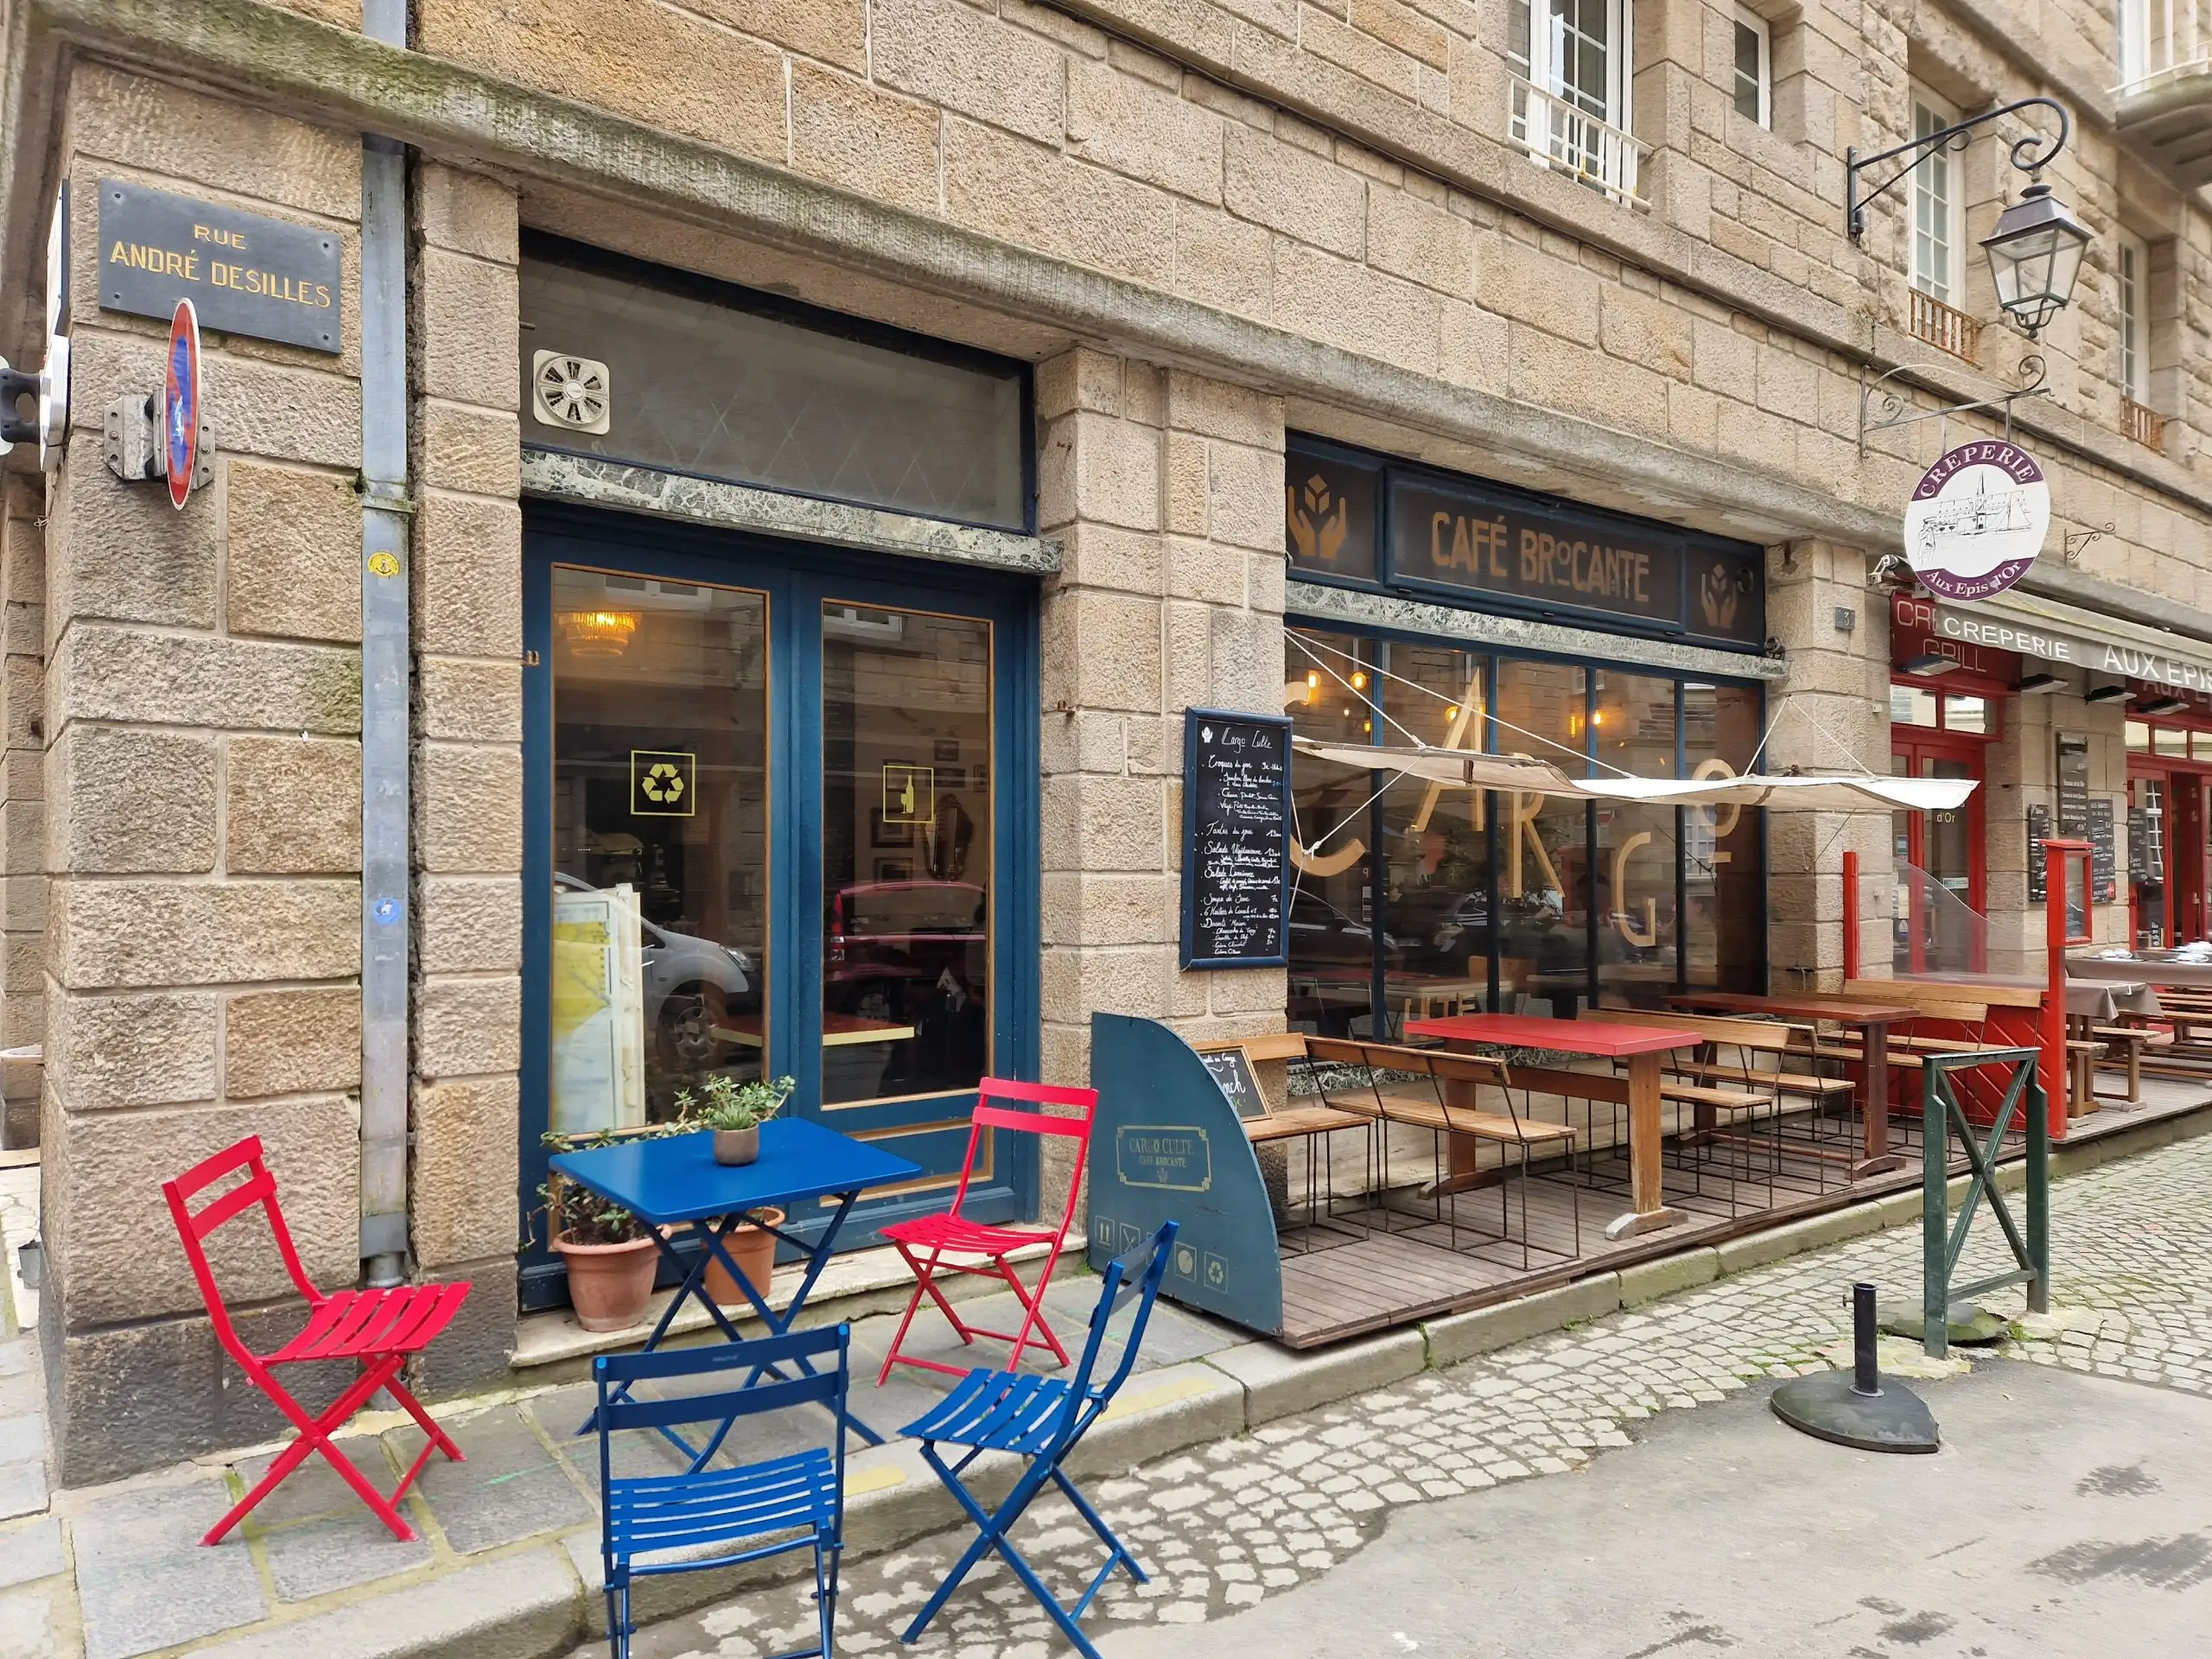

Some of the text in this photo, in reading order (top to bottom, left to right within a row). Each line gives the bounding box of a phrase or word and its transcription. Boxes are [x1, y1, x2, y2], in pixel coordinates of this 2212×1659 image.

[193, 224, 246, 250] RUE
[110, 240, 331, 308] ANDRÉ DESILLES
[1920, 444, 2036, 498] CREPERIE
[1431, 511, 1508, 577] CAFÉ
[1926, 570, 1954, 592] Aux
[1954, 582, 1989, 597] Epis
[1923, 638, 1987, 672] GRILL
[1943, 617, 2071, 661] CREPERIE
[2104, 644, 2161, 679] AUX
[1936, 811, 1955, 823] d'Or
[1204, 841, 1229, 855] Salade
[1204, 866, 1227, 879] Salade
[1162, 1137, 1194, 1155] CULTE
